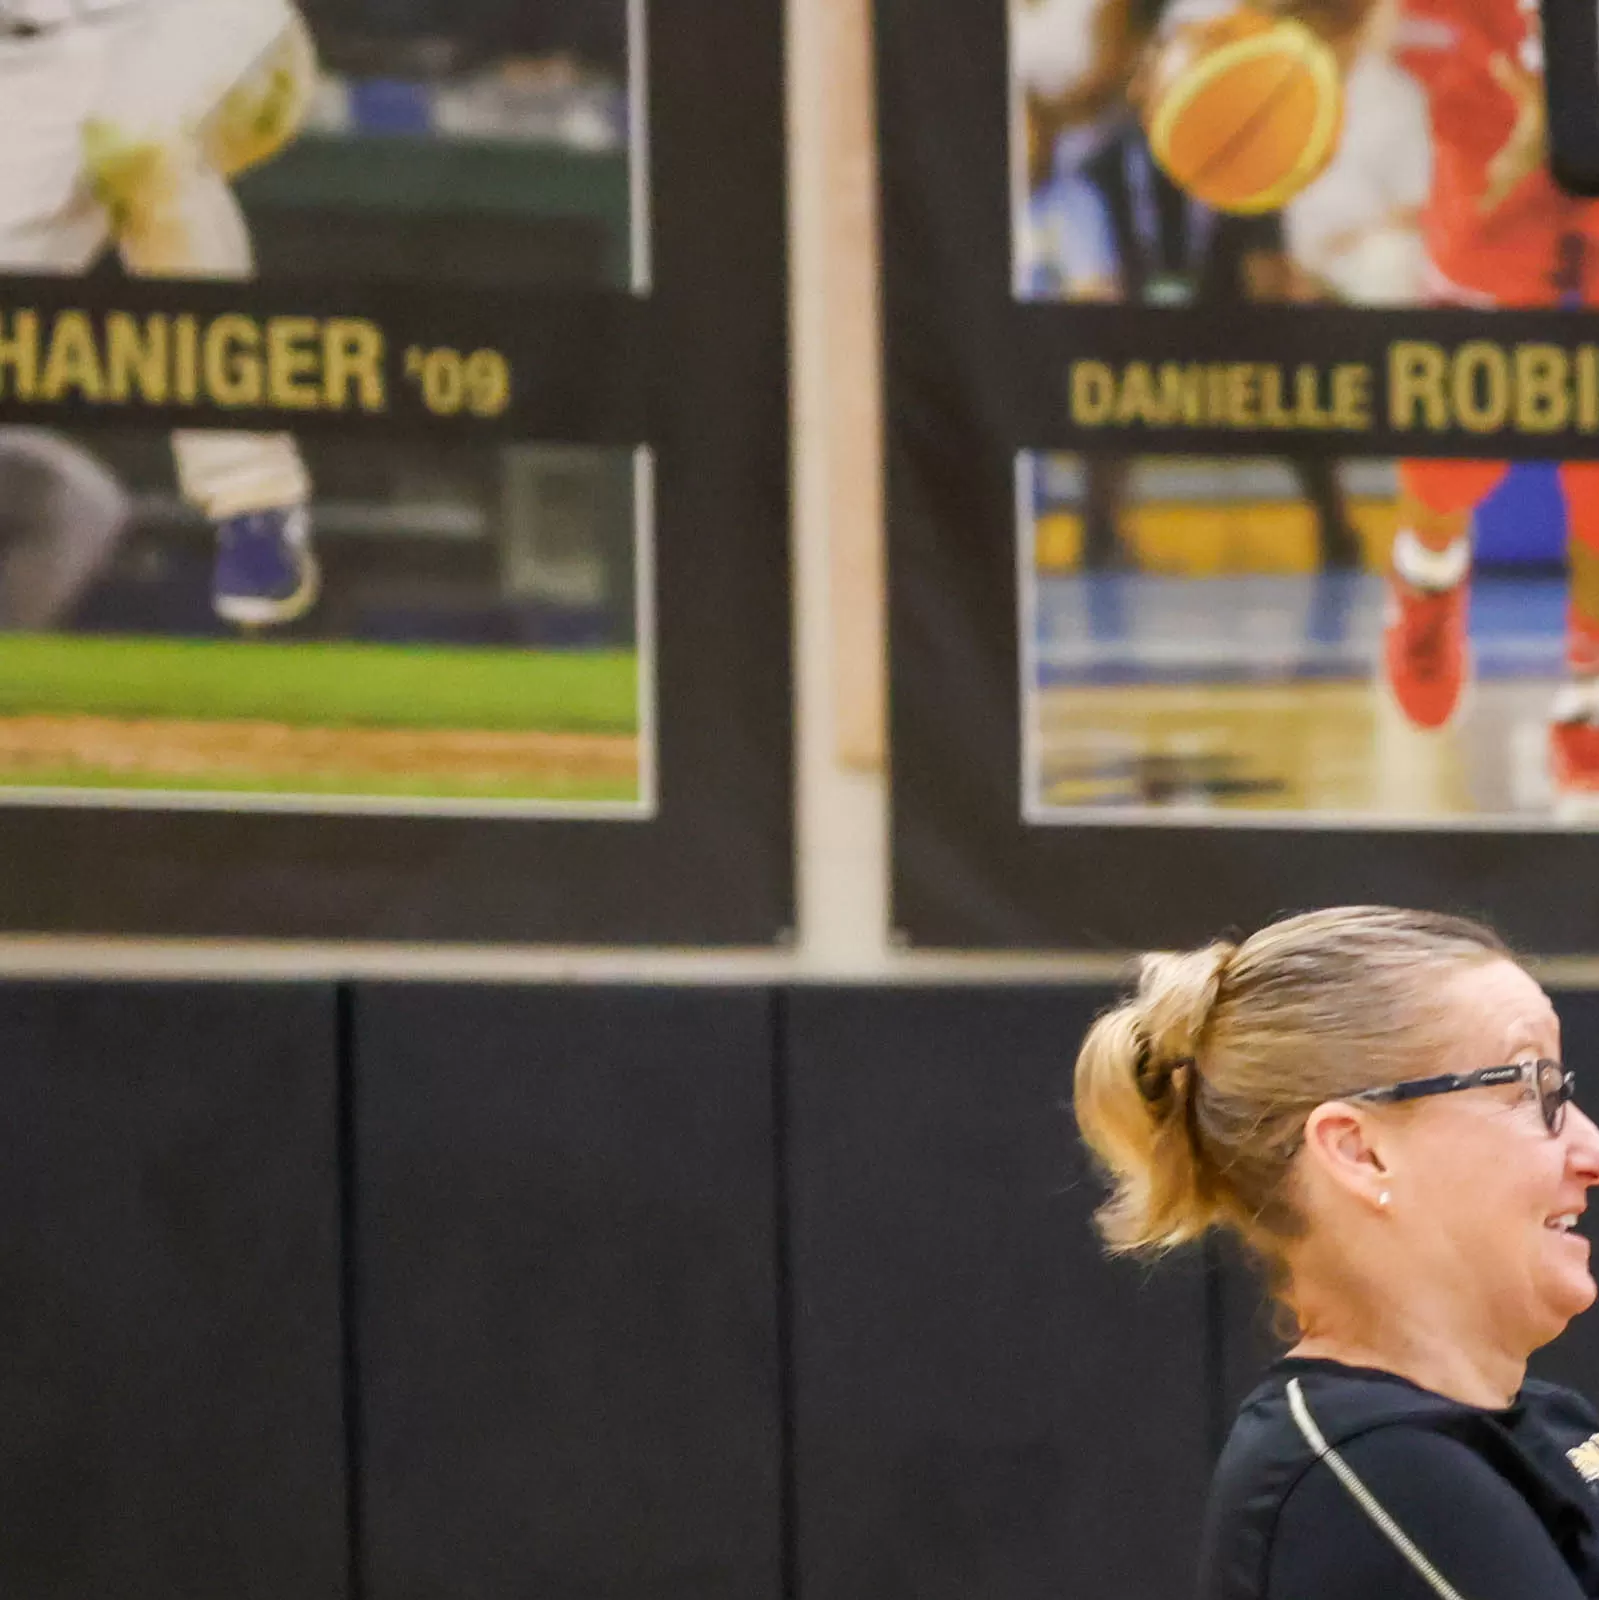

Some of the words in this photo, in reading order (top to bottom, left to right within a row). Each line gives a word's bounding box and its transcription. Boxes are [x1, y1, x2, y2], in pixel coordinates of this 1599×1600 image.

[0, 308, 385, 412] HANIGER
[404, 344, 511, 417] '09
[1069, 359, 1372, 430] DANIELLE
